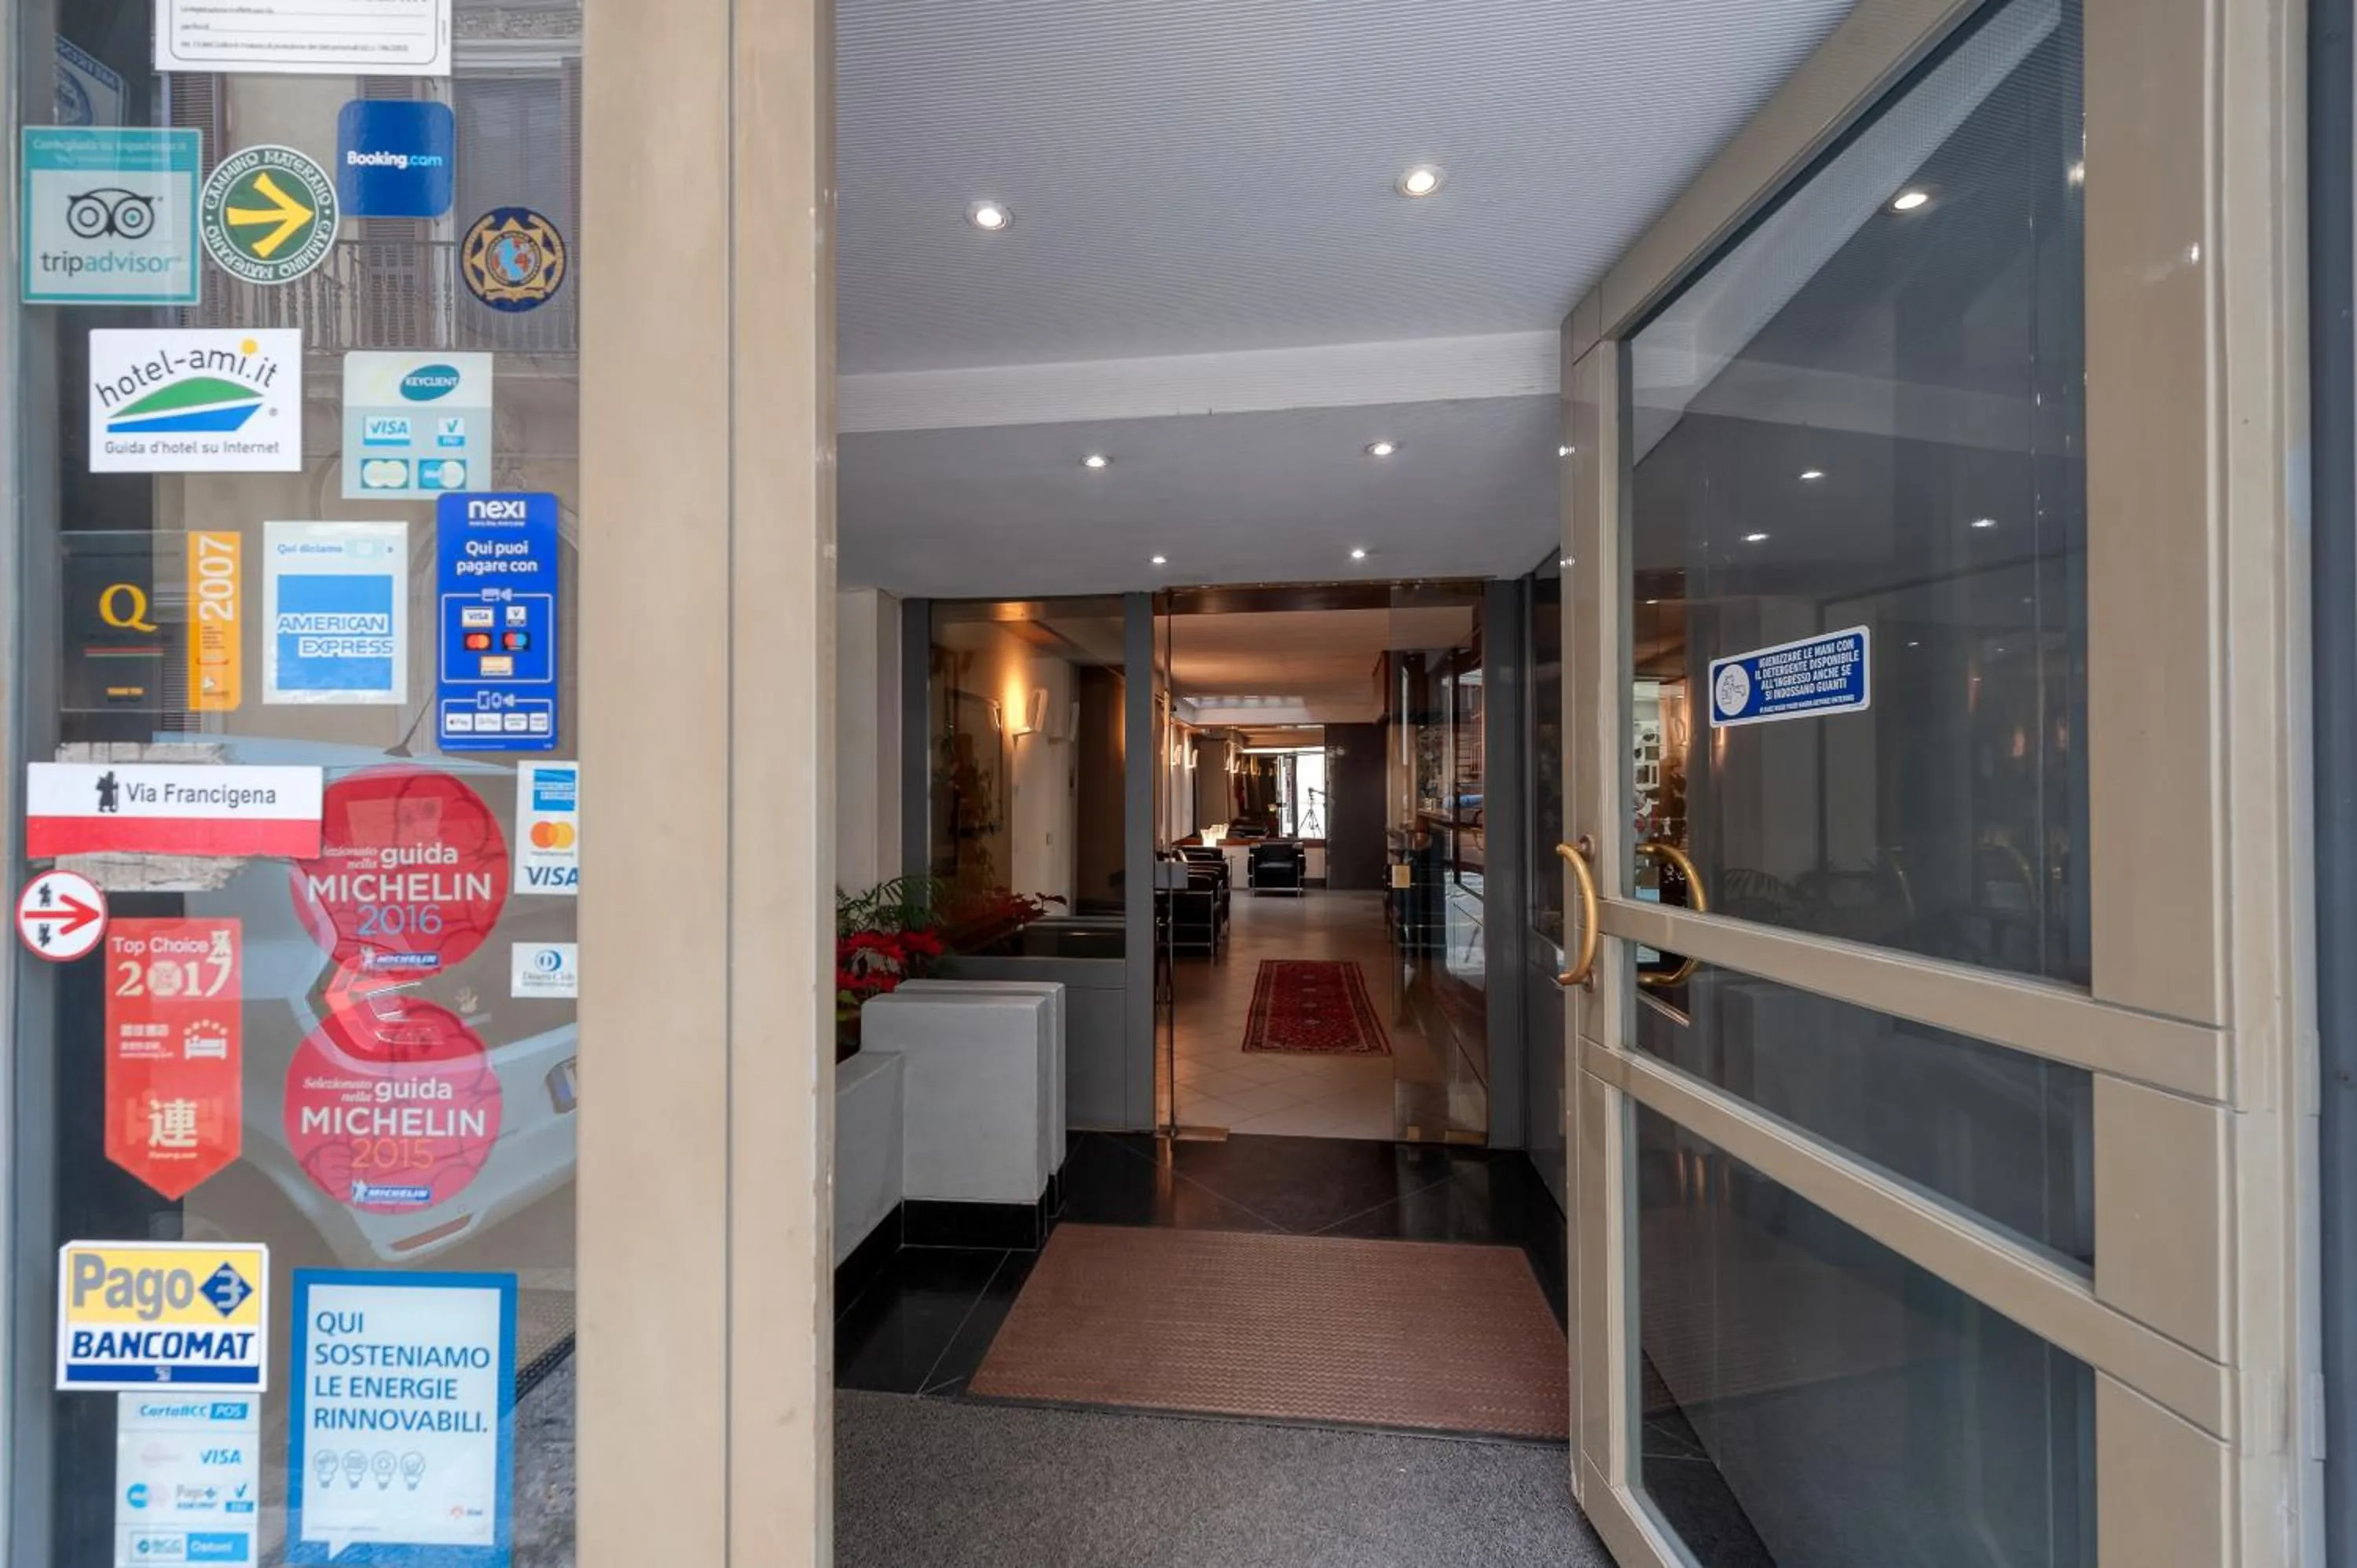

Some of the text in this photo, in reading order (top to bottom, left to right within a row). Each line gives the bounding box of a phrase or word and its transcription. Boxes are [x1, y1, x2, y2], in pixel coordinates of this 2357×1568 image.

[346, 150, 442, 170] Booking.com
[204, 150, 332, 210] CAMMINO MATERANO
[40, 251, 172, 277] tripadvisor
[95, 348, 277, 408] hotel-ami.it
[405, 376, 457, 387] KEYCLIENT
[369, 420, 408, 434] VISA
[104, 441, 280, 455] Guida d'hotel su Internet
[468, 500, 526, 518] nexi
[465, 540, 529, 558] Qui puoi
[199, 535, 234, 621] 2007
[456, 560, 538, 576] pagare con
[99, 582, 159, 632] Q
[277, 615, 386, 631] AMERICAN
[302, 639, 394, 654] EXPRESS
[1759, 638, 1854, 668] IGIENIZZARE LE MANI CON
[1754, 650, 1860, 681] IL DETERGENTE DISPONIBILE
[1813, 666, 1839, 682] ANCHE
[1842, 664, 1852, 676] SE
[1765, 677, 1847, 702] SI INDOSSANO GUANTI
[126, 783, 277, 809] Via Francigena
[322, 841, 460, 869] lezionato guida
[307, 872, 493, 903] MICHELIN
[525, 866, 578, 886] VISA
[357, 904, 443, 936] 2016
[111, 936, 210, 956] Top Choice
[374, 1077, 453, 1103] guida
[301, 1105, 486, 1137] MICHELIN
[351, 1138, 435, 1170] 2015
[72, 1253, 195, 1321] Pago
[316, 1311, 365, 1336] QUI
[71, 1331, 255, 1360] BANCOMAT
[315, 1343, 491, 1369] SOSTENIAMO
[314, 1376, 458, 1400] LE ENERGIE
[313, 1407, 489, 1433] RINNOVABILI.
[200, 1449, 242, 1465] VISA
